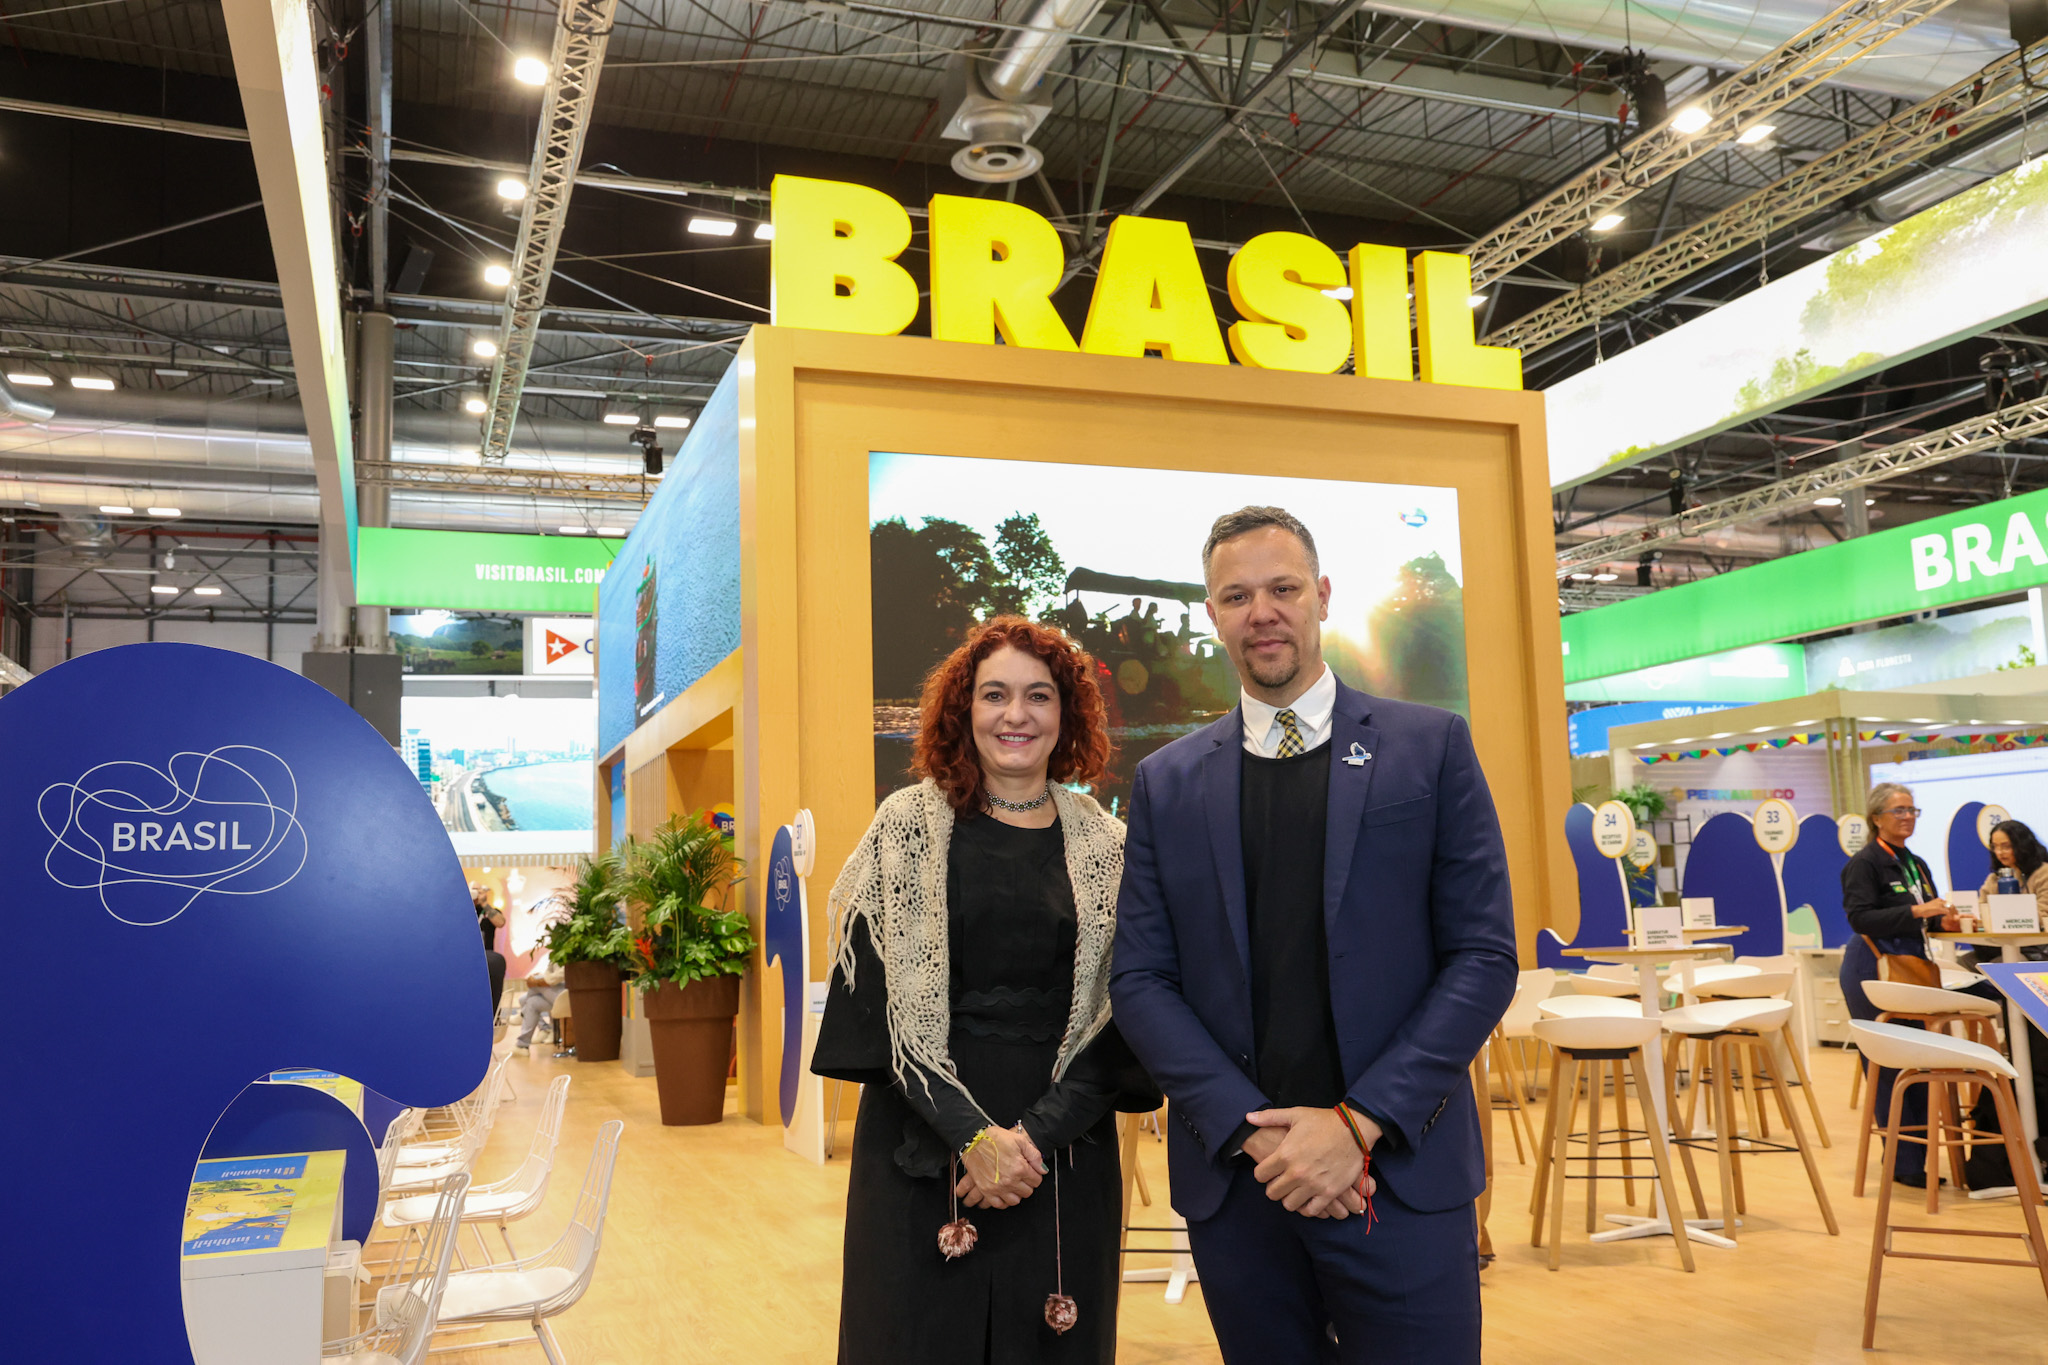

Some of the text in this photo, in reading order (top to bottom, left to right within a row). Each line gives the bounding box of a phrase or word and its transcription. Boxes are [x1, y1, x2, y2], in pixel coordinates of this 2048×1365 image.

[771, 174, 1523, 391] BRASIL
[1911, 511, 2048, 592] BRA
[475, 563, 606, 584] VISITBRASIL.COM
[1686, 789, 1795, 800] PERNAMBUCO
[1604, 813, 1617, 827] 34
[1766, 810, 1780, 824] 33
[1850, 823, 1862, 834] 27
[113, 821, 252, 852] BRASIL
[1636, 837, 1647, 848] 25
